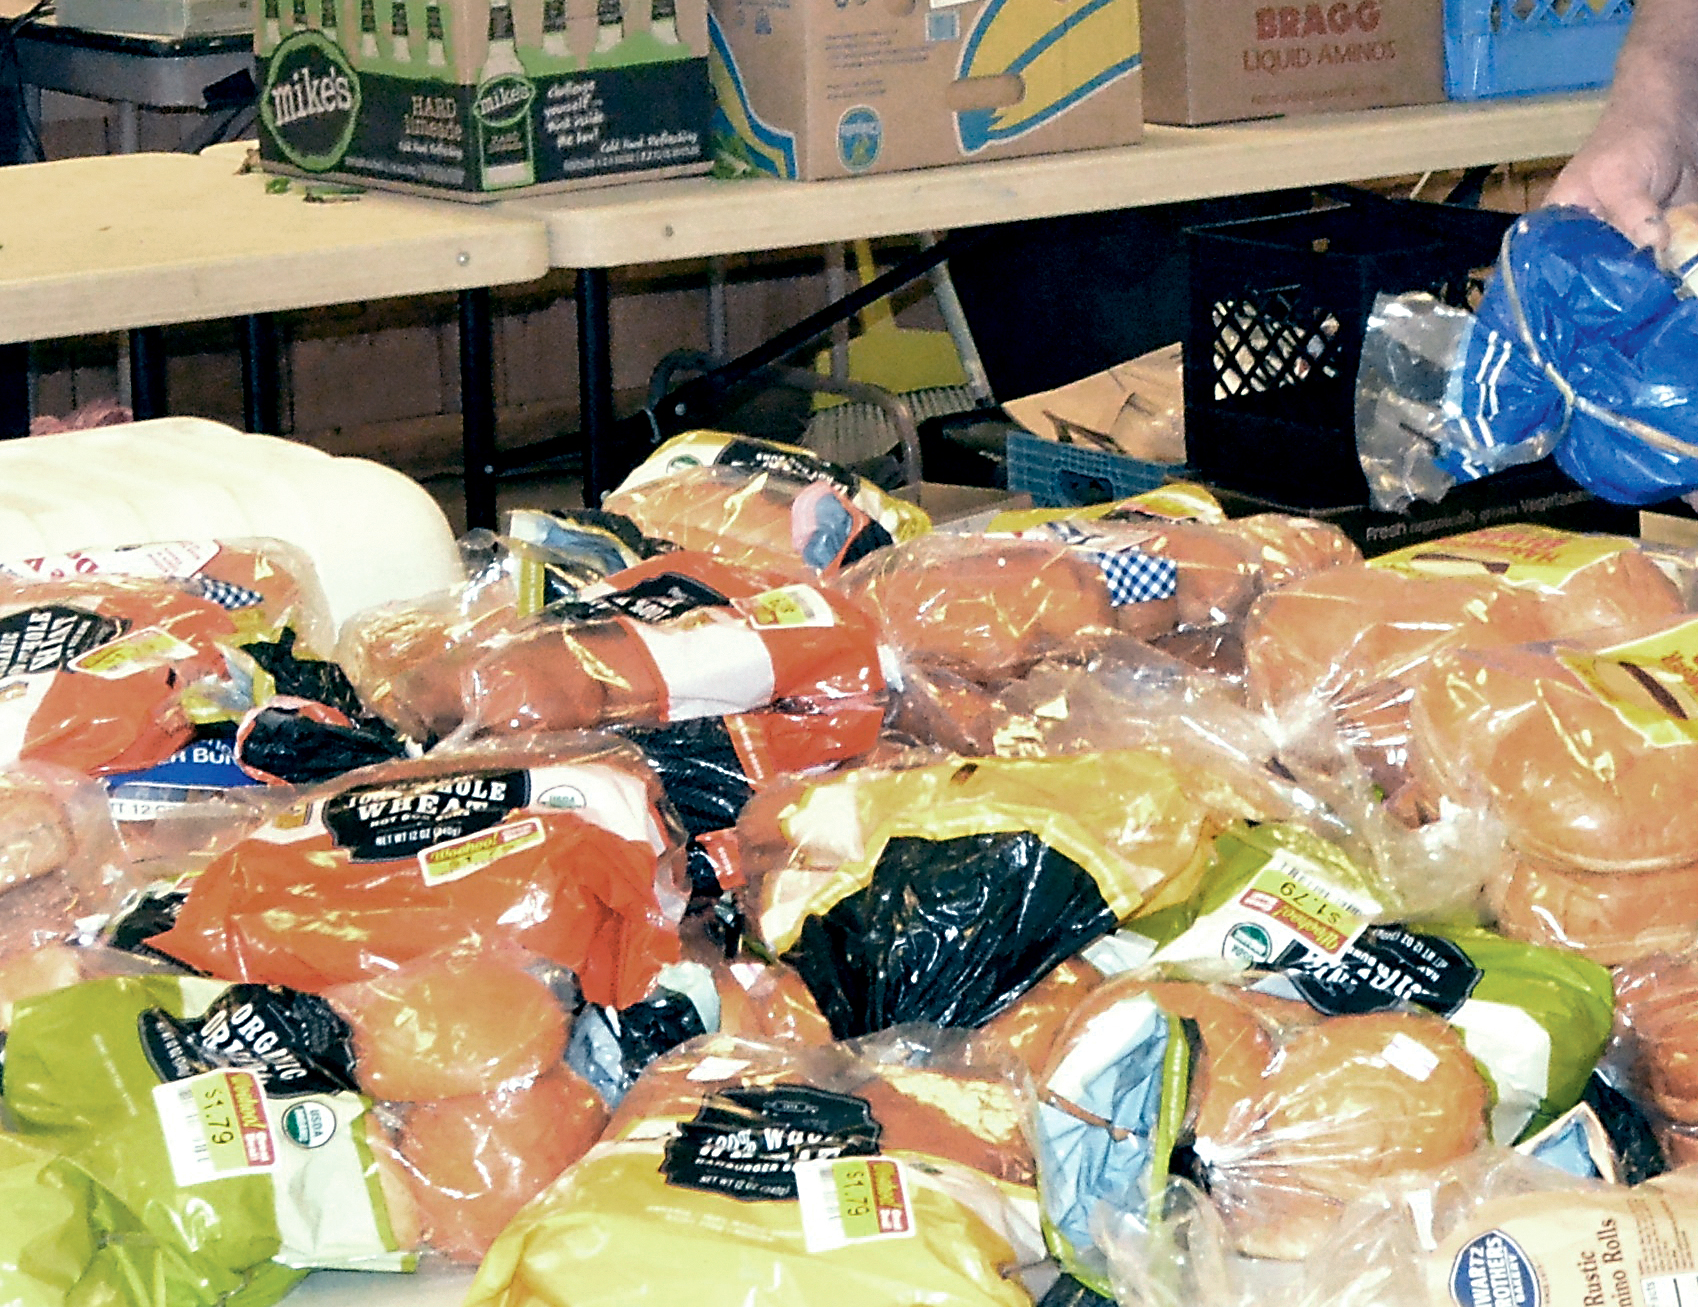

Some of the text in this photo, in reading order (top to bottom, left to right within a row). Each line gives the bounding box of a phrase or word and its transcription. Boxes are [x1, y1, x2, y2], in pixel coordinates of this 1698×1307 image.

[1255, 0, 1382, 41] BRAGG
[1243, 41, 1395, 75] LIQUID AMINOS
[272, 67, 352, 126] mike's
[412, 95, 457, 118] HARD
[1366, 522, 1407, 541] Fresh
[133, 804, 150, 815] 12
[409, 830, 418, 841] 12
[419, 828, 431, 839] OZ
[1280, 881, 1341, 924] $1.79
[1271, 905, 1340, 951] Woohoo!
[204, 1089, 235, 1144] $1.79
[309, 1109, 323, 1137] USDA
[843, 1172, 870, 1217] $1.79
[1597, 1218, 1623, 1264] Rolls
[1508, 1255, 1525, 1304] BAKERY
[1578, 1250, 1605, 1307] Rustic
